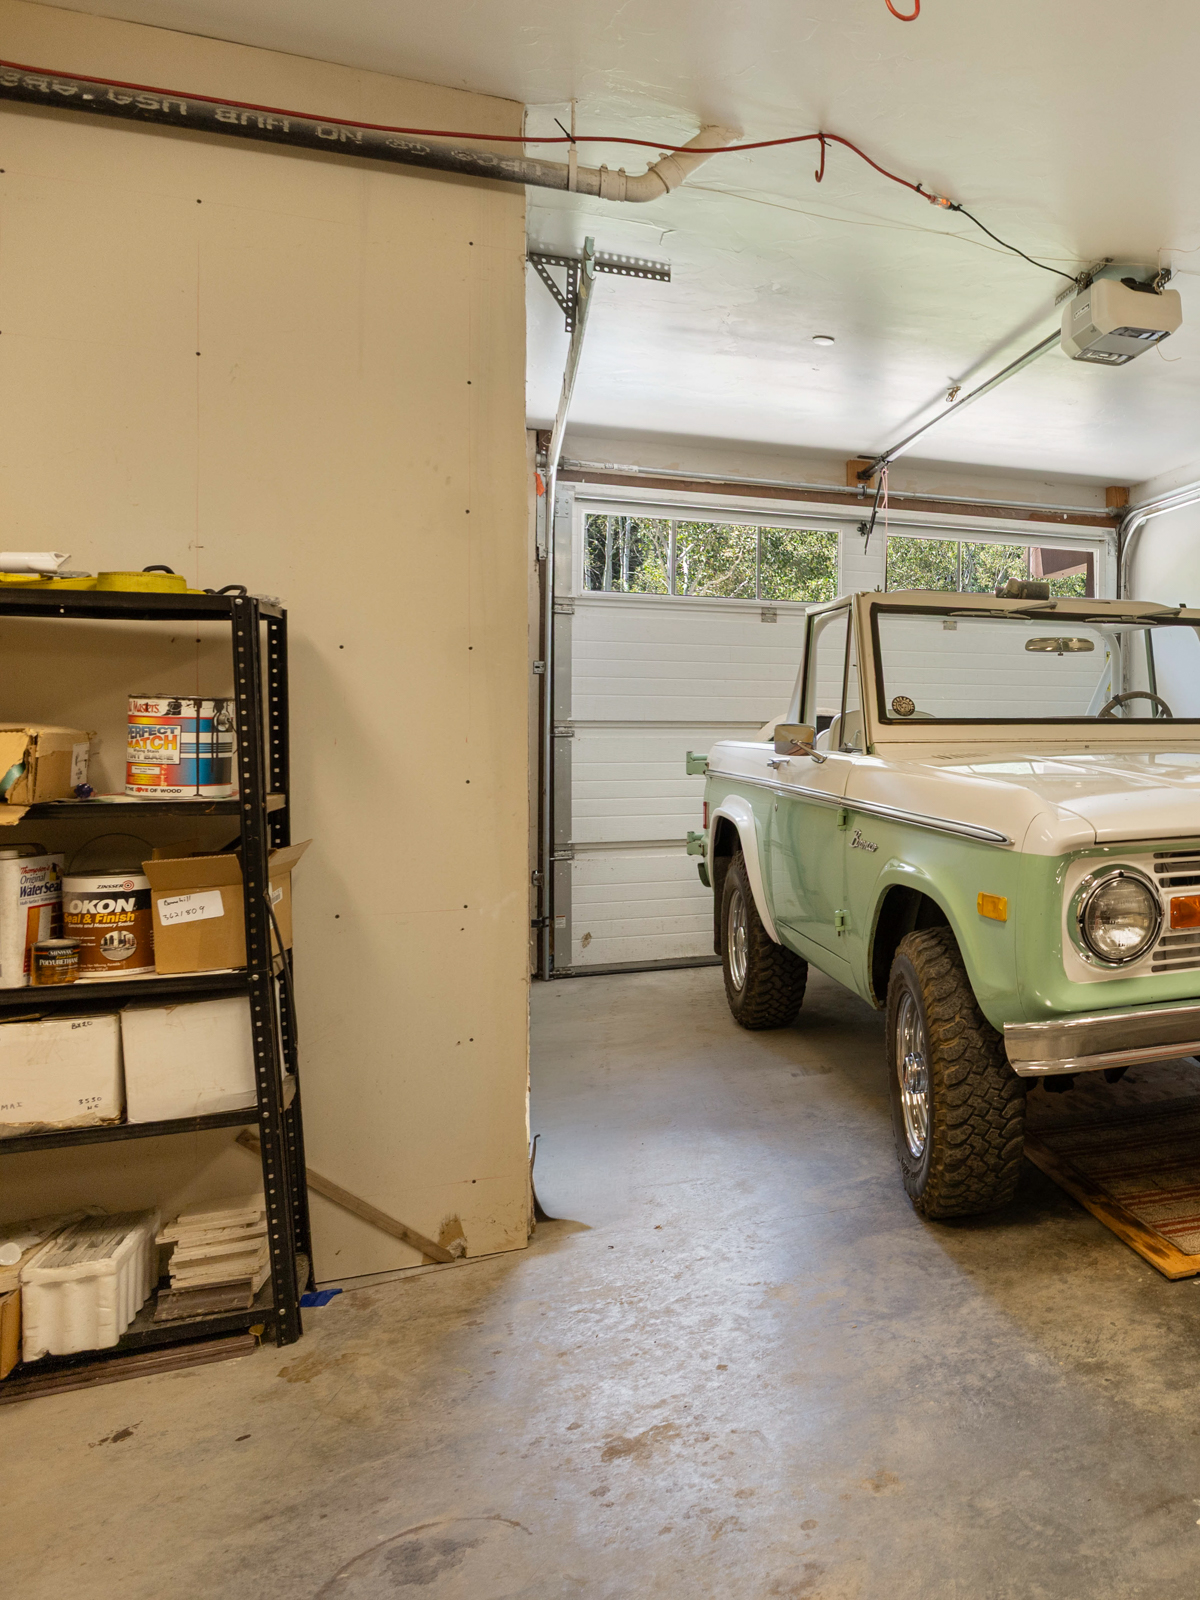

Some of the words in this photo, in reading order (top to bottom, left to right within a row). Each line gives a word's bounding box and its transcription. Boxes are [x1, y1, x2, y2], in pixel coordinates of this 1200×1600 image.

[107, 88, 188, 116] USA
[214, 107, 291, 133] HUB
[315, 124, 363, 145] NO
[133, 700, 160, 714] Masters
[20, 873, 46, 885] Original
[69, 898, 136, 914] OKON
[64, 913, 81, 924] Seal
[83, 913, 92, 924] &
[95, 912, 135, 924] Finish
